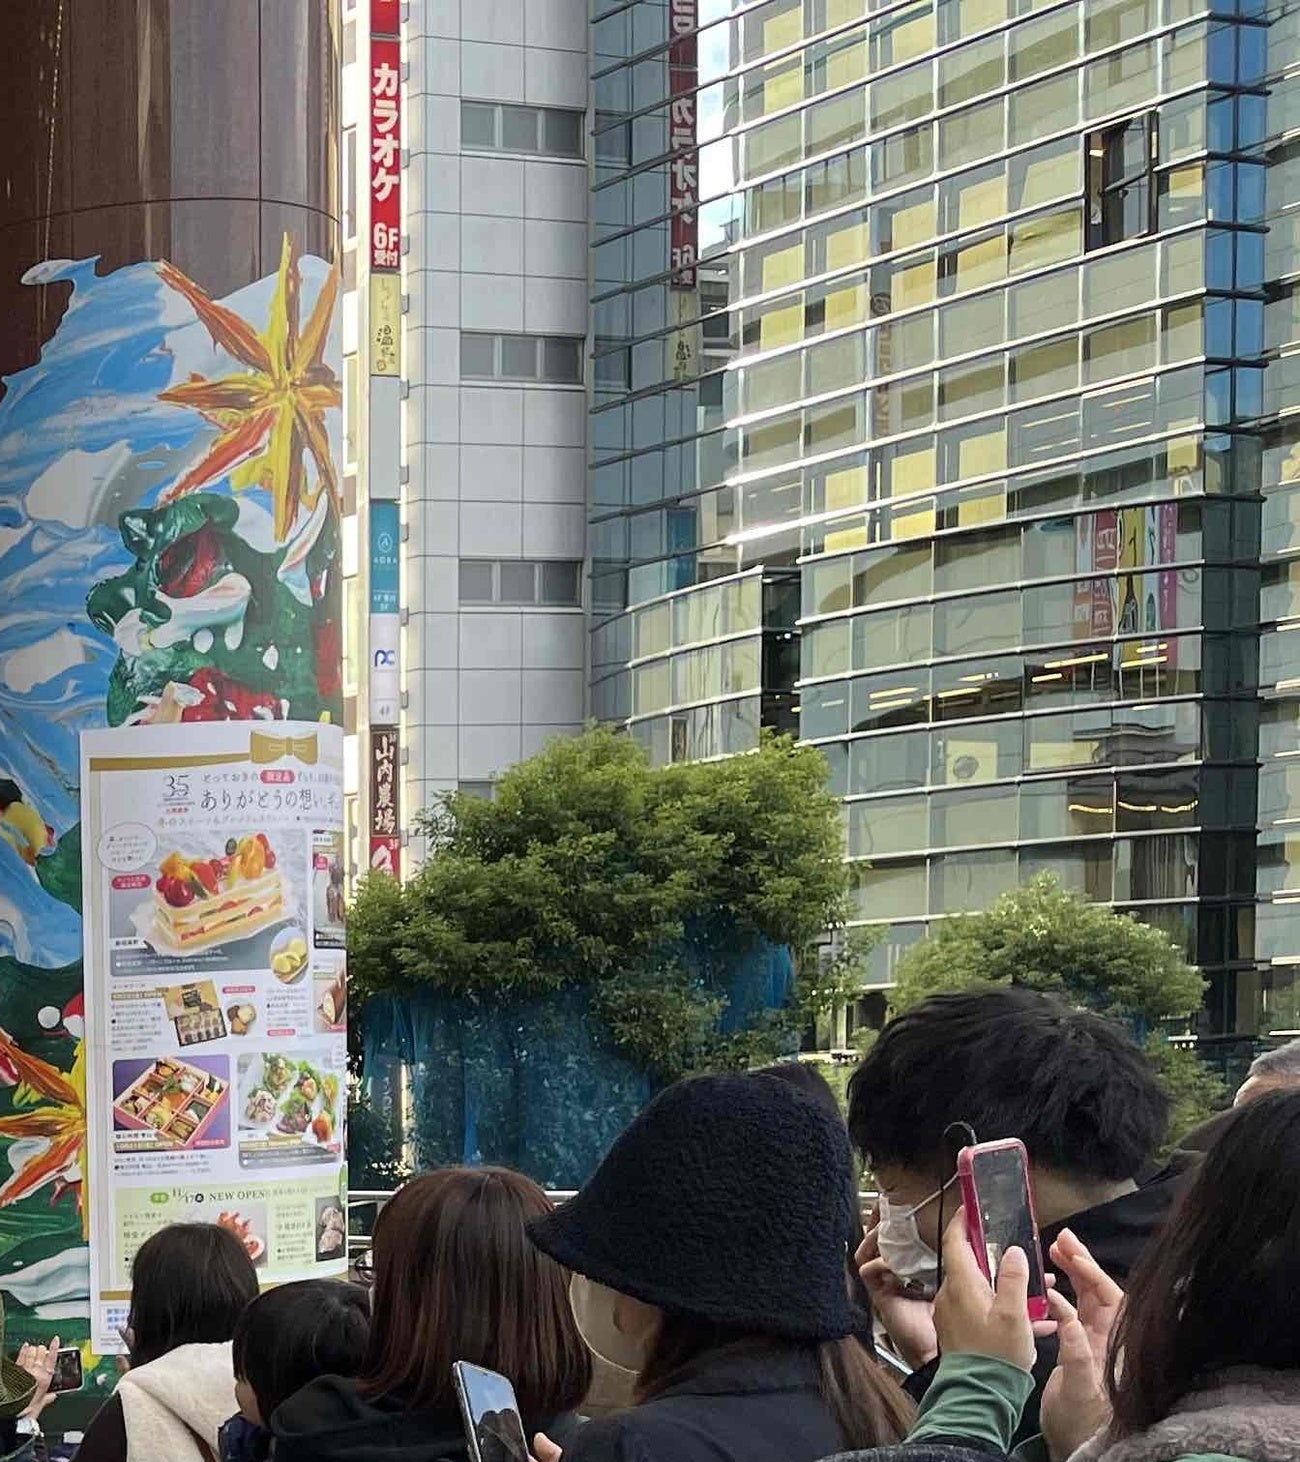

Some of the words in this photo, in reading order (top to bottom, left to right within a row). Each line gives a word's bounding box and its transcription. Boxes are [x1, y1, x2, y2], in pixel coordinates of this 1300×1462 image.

[372, 62, 400, 202] カラオケ
[373, 222, 399, 247] 6F
[375, 734, 396, 835] 山内農場
[210, 1191, 234, 1202] NEW
